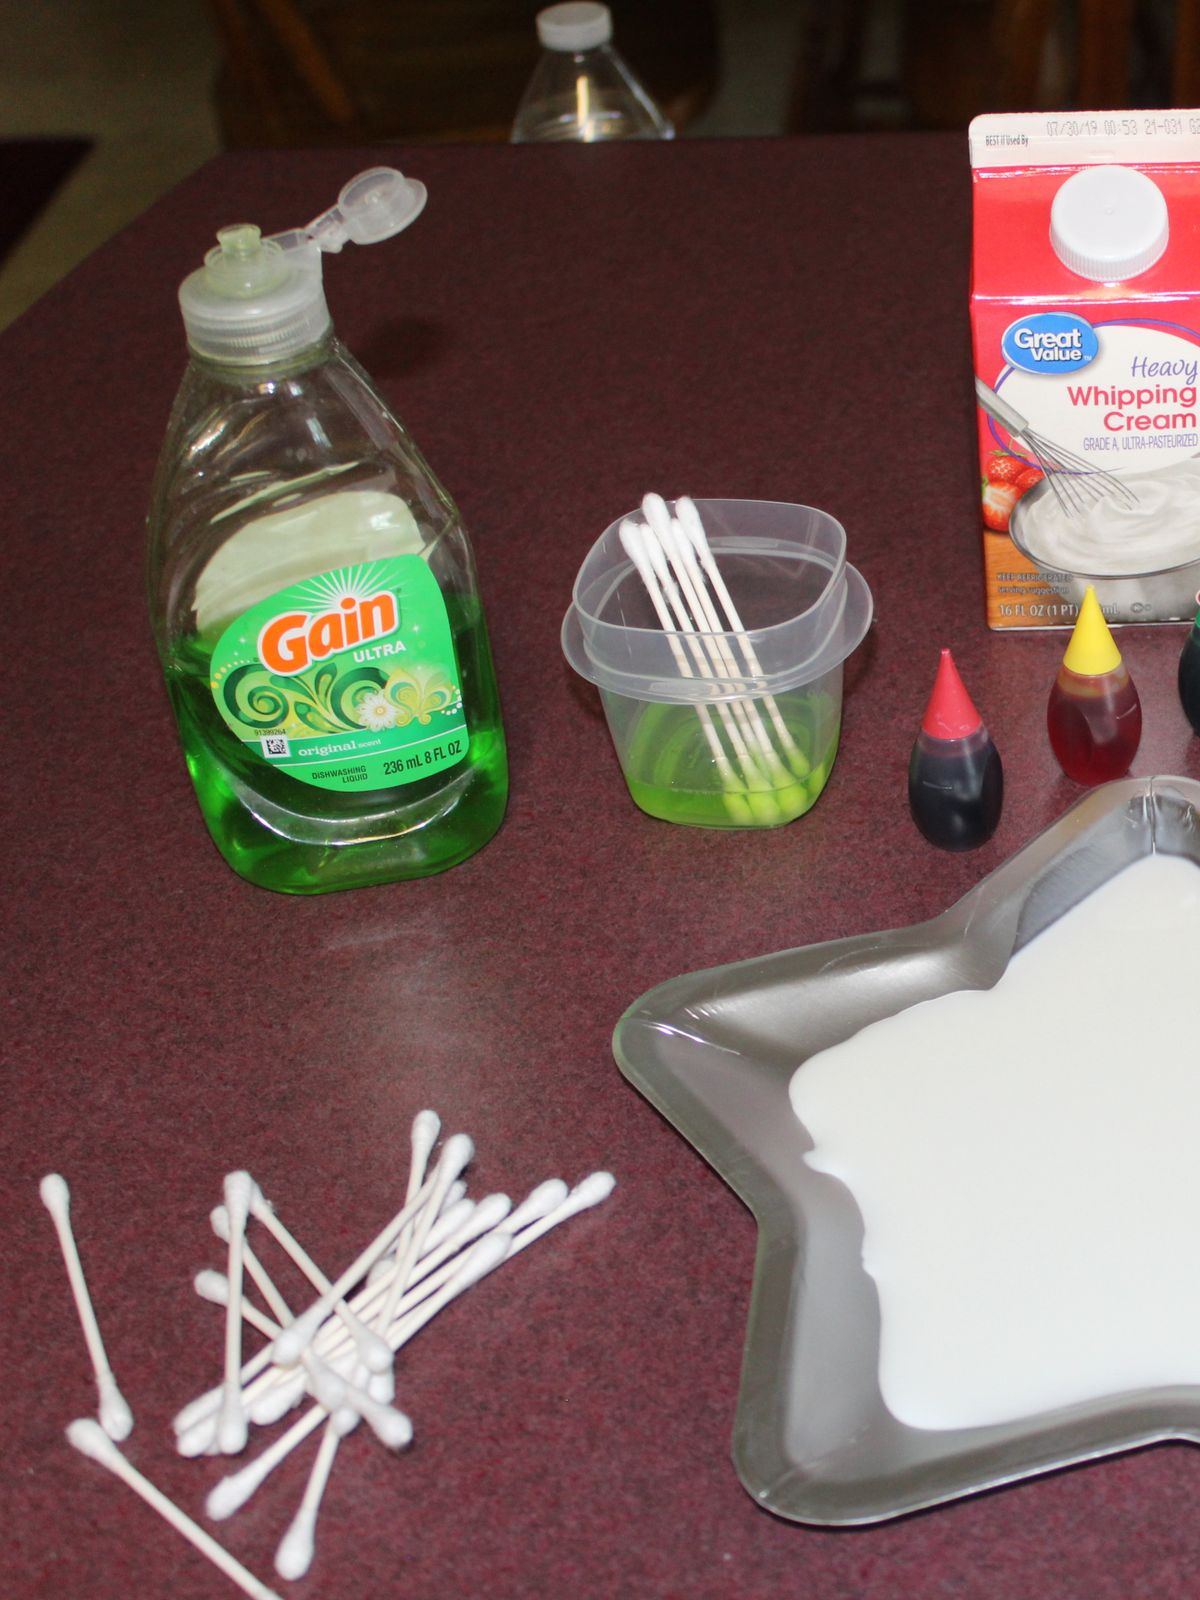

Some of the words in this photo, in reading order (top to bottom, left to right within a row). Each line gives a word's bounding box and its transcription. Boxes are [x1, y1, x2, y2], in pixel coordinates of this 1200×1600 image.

[1046, 120, 1098, 136] 07/30/19
[985, 135, 1000, 146] BEST
[1014, 328, 1081, 350] Great
[1030, 346, 1082, 362] Value
[1131, 356, 1198, 385] Heavy
[1067, 383, 1198, 411] Whipping
[1103, 411, 1197, 432] Cream
[1083, 437, 1111, 451] GRADE
[1122, 433, 1199, 450] ULTRA-PASTEURIZED
[1000, 604, 1012, 616] 16
[1015, 604, 1026, 616] FL
[1030, 604, 1044, 616] OZ
[1047, 603, 1058, 616] (1
[1060, 603, 1079, 617] PT)
[260, 592, 397, 674] Gain
[353, 640, 406, 664] ULTRA
[298, 740, 357, 757] original
[358, 738, 382, 748] scent
[383, 758, 404, 775] 236
[406, 754, 423, 770] mL
[424, 751, 432, 764] 8
[433, 746, 447, 761] FL
[447, 740, 462, 756] OZ
[311, 765, 367, 780] DISHWASHING
[342, 773, 368, 784] LIQUID
